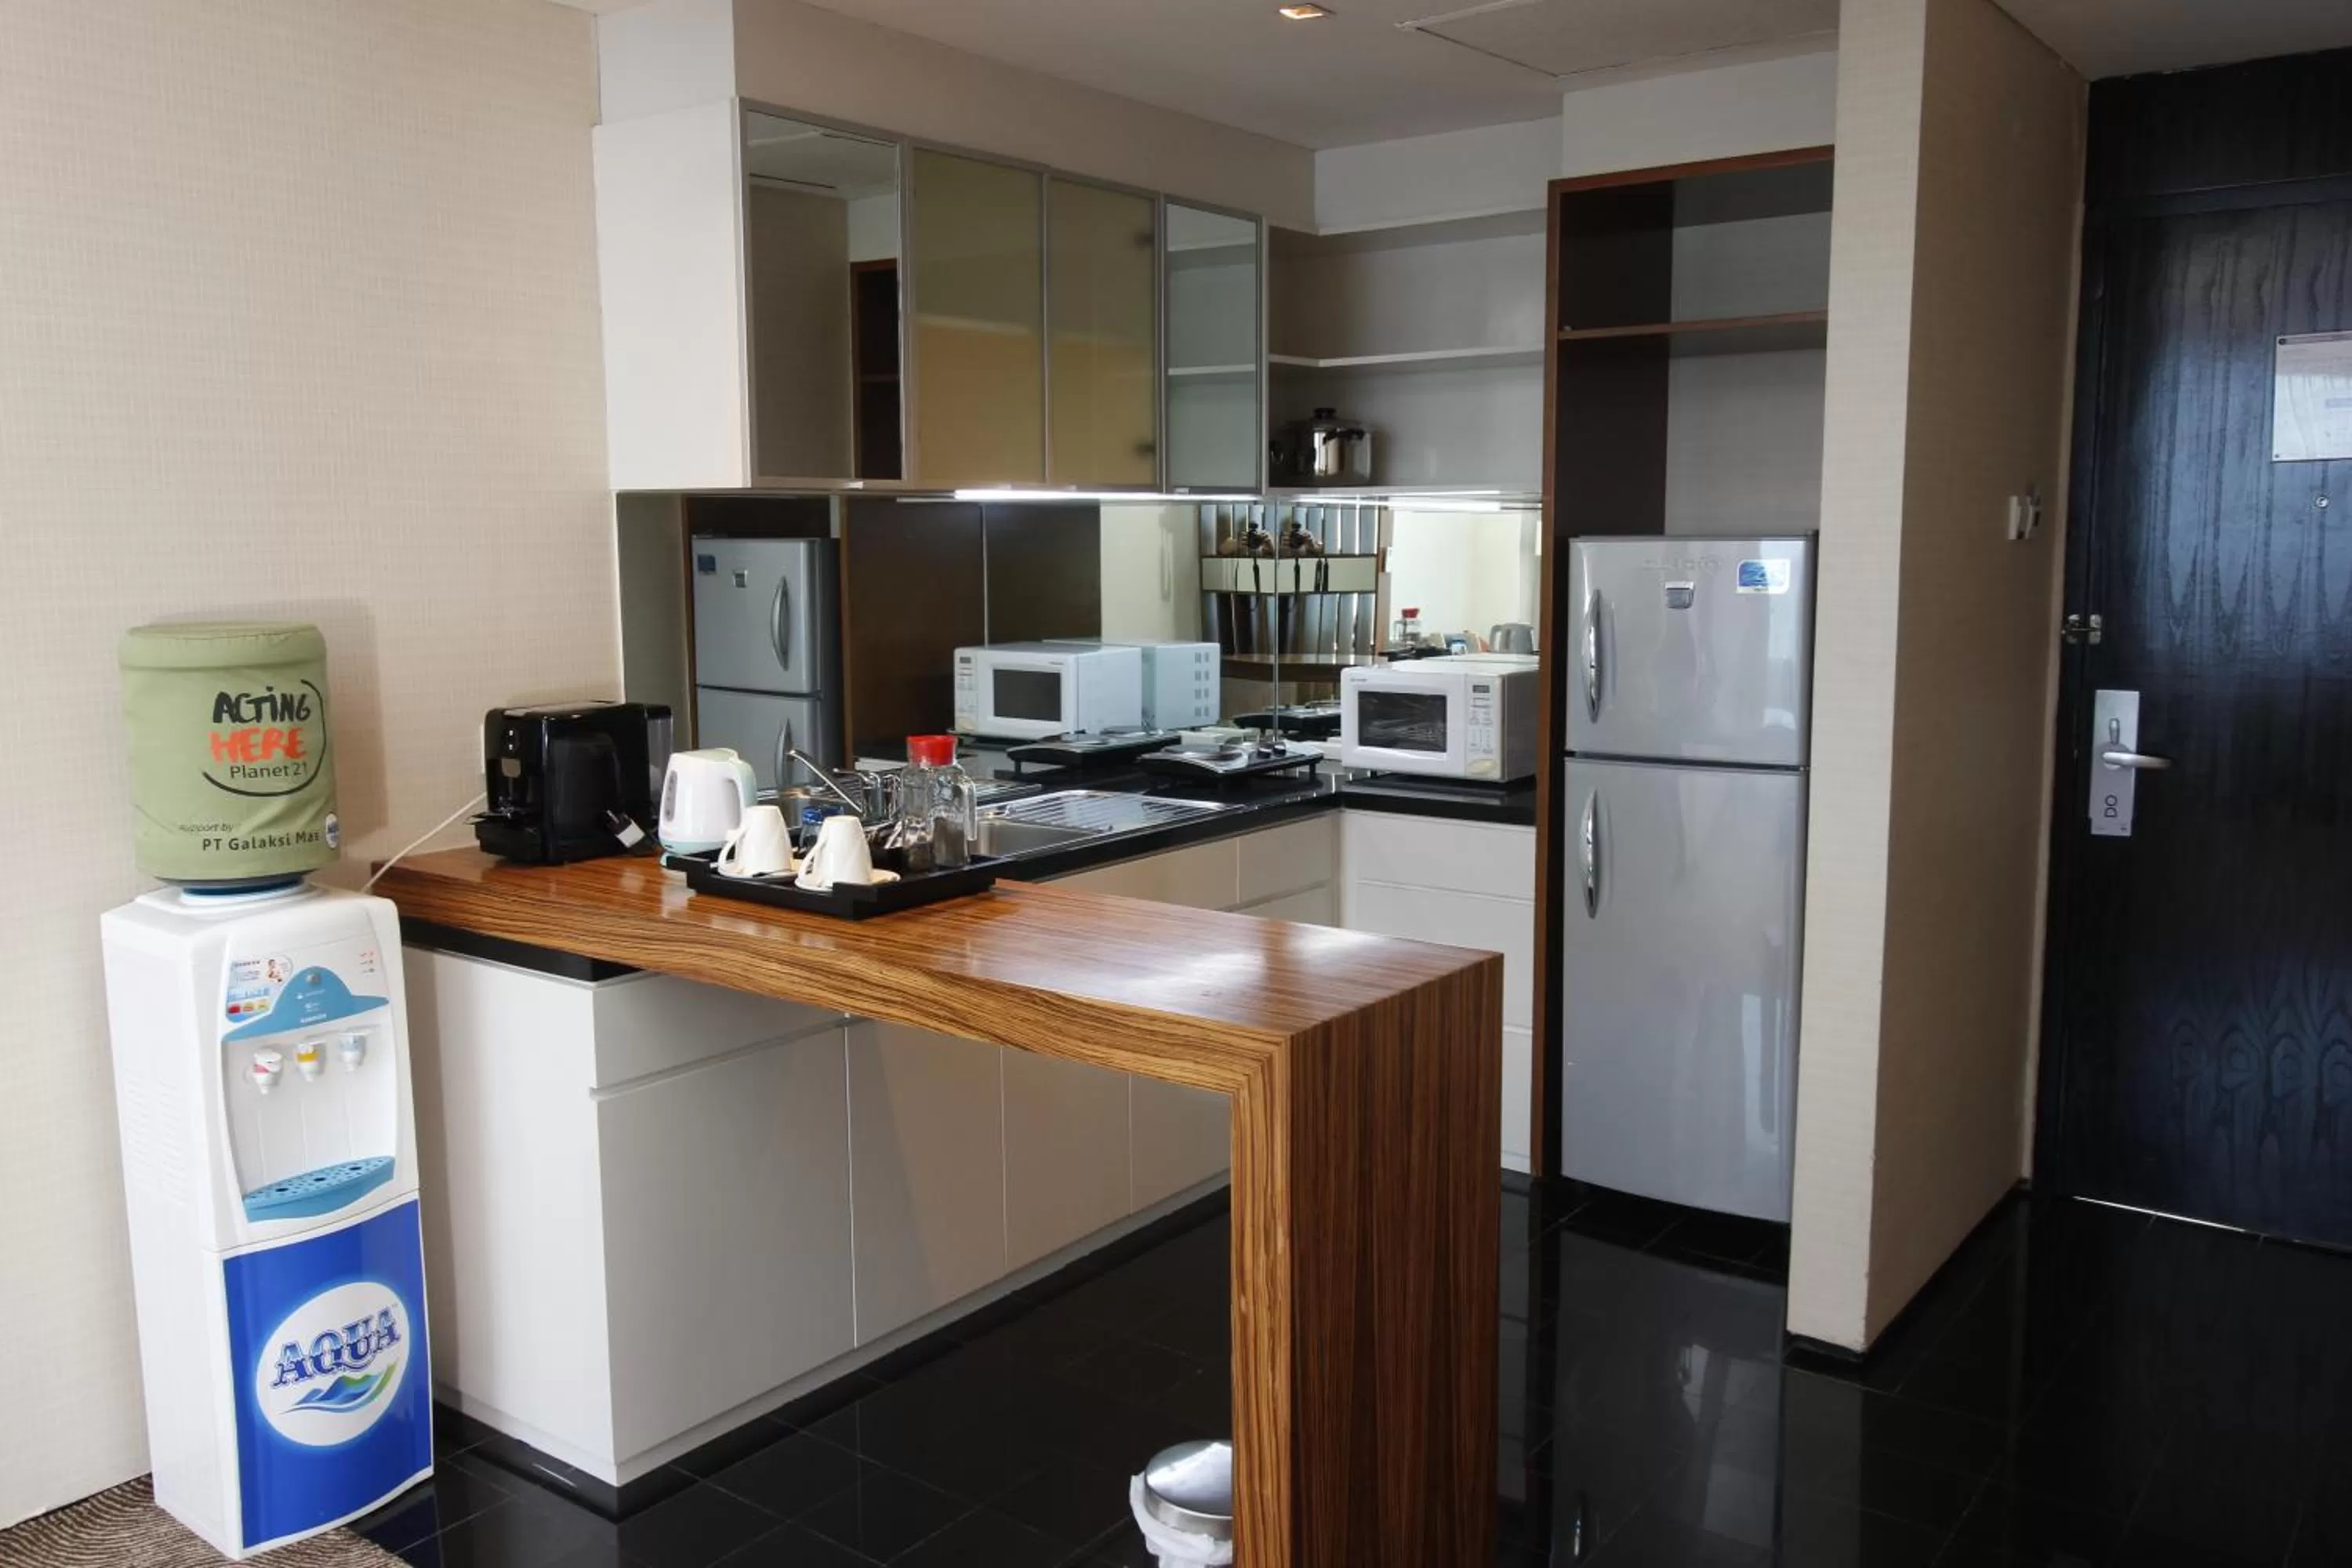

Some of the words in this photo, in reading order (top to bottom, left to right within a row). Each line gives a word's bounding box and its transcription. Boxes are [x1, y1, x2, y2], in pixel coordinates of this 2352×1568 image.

[209, 728, 307, 764] HERE
[230, 765, 289, 779] Planet
[202, 838, 223, 851] PT
[229, 833, 290, 851] Galaksi
[271, 1306, 401, 1388] AQUA
